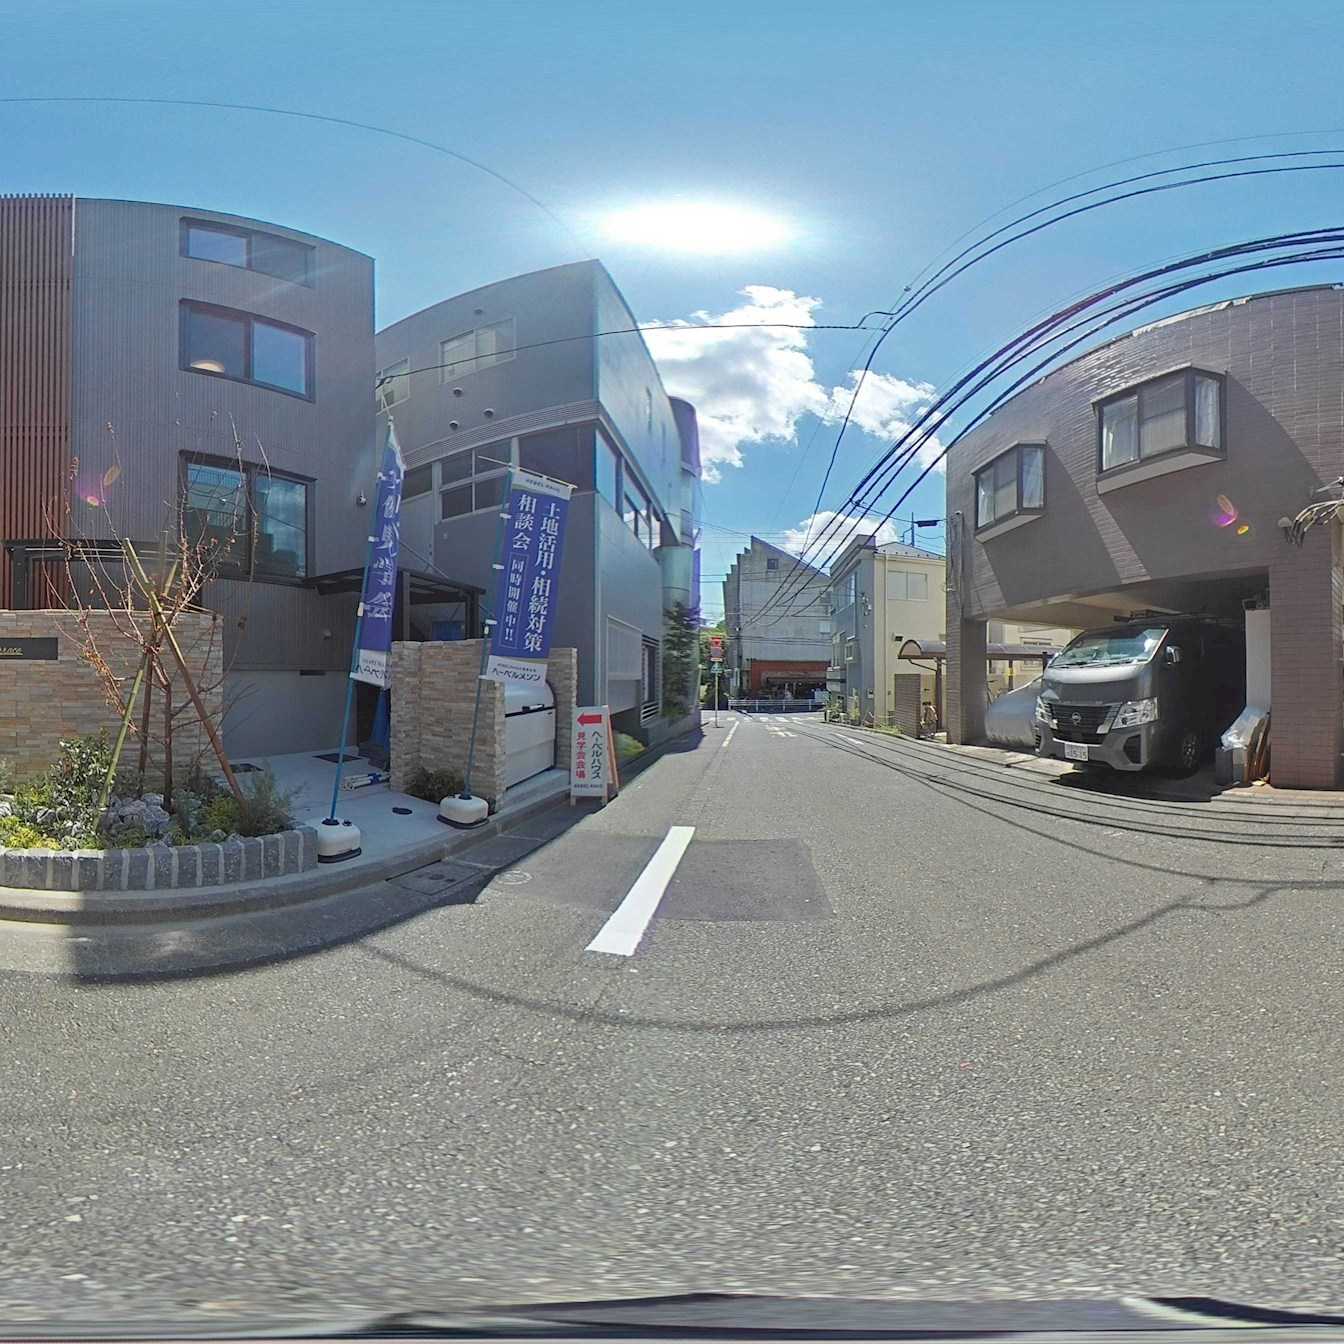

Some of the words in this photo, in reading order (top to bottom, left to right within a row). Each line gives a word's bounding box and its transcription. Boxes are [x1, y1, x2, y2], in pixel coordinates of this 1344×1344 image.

[513, 494, 537, 551] 相談会
[523, 502, 561, 652] 土地活用・相続対策
[591, 730, 603, 779] ヘーベルハウス
